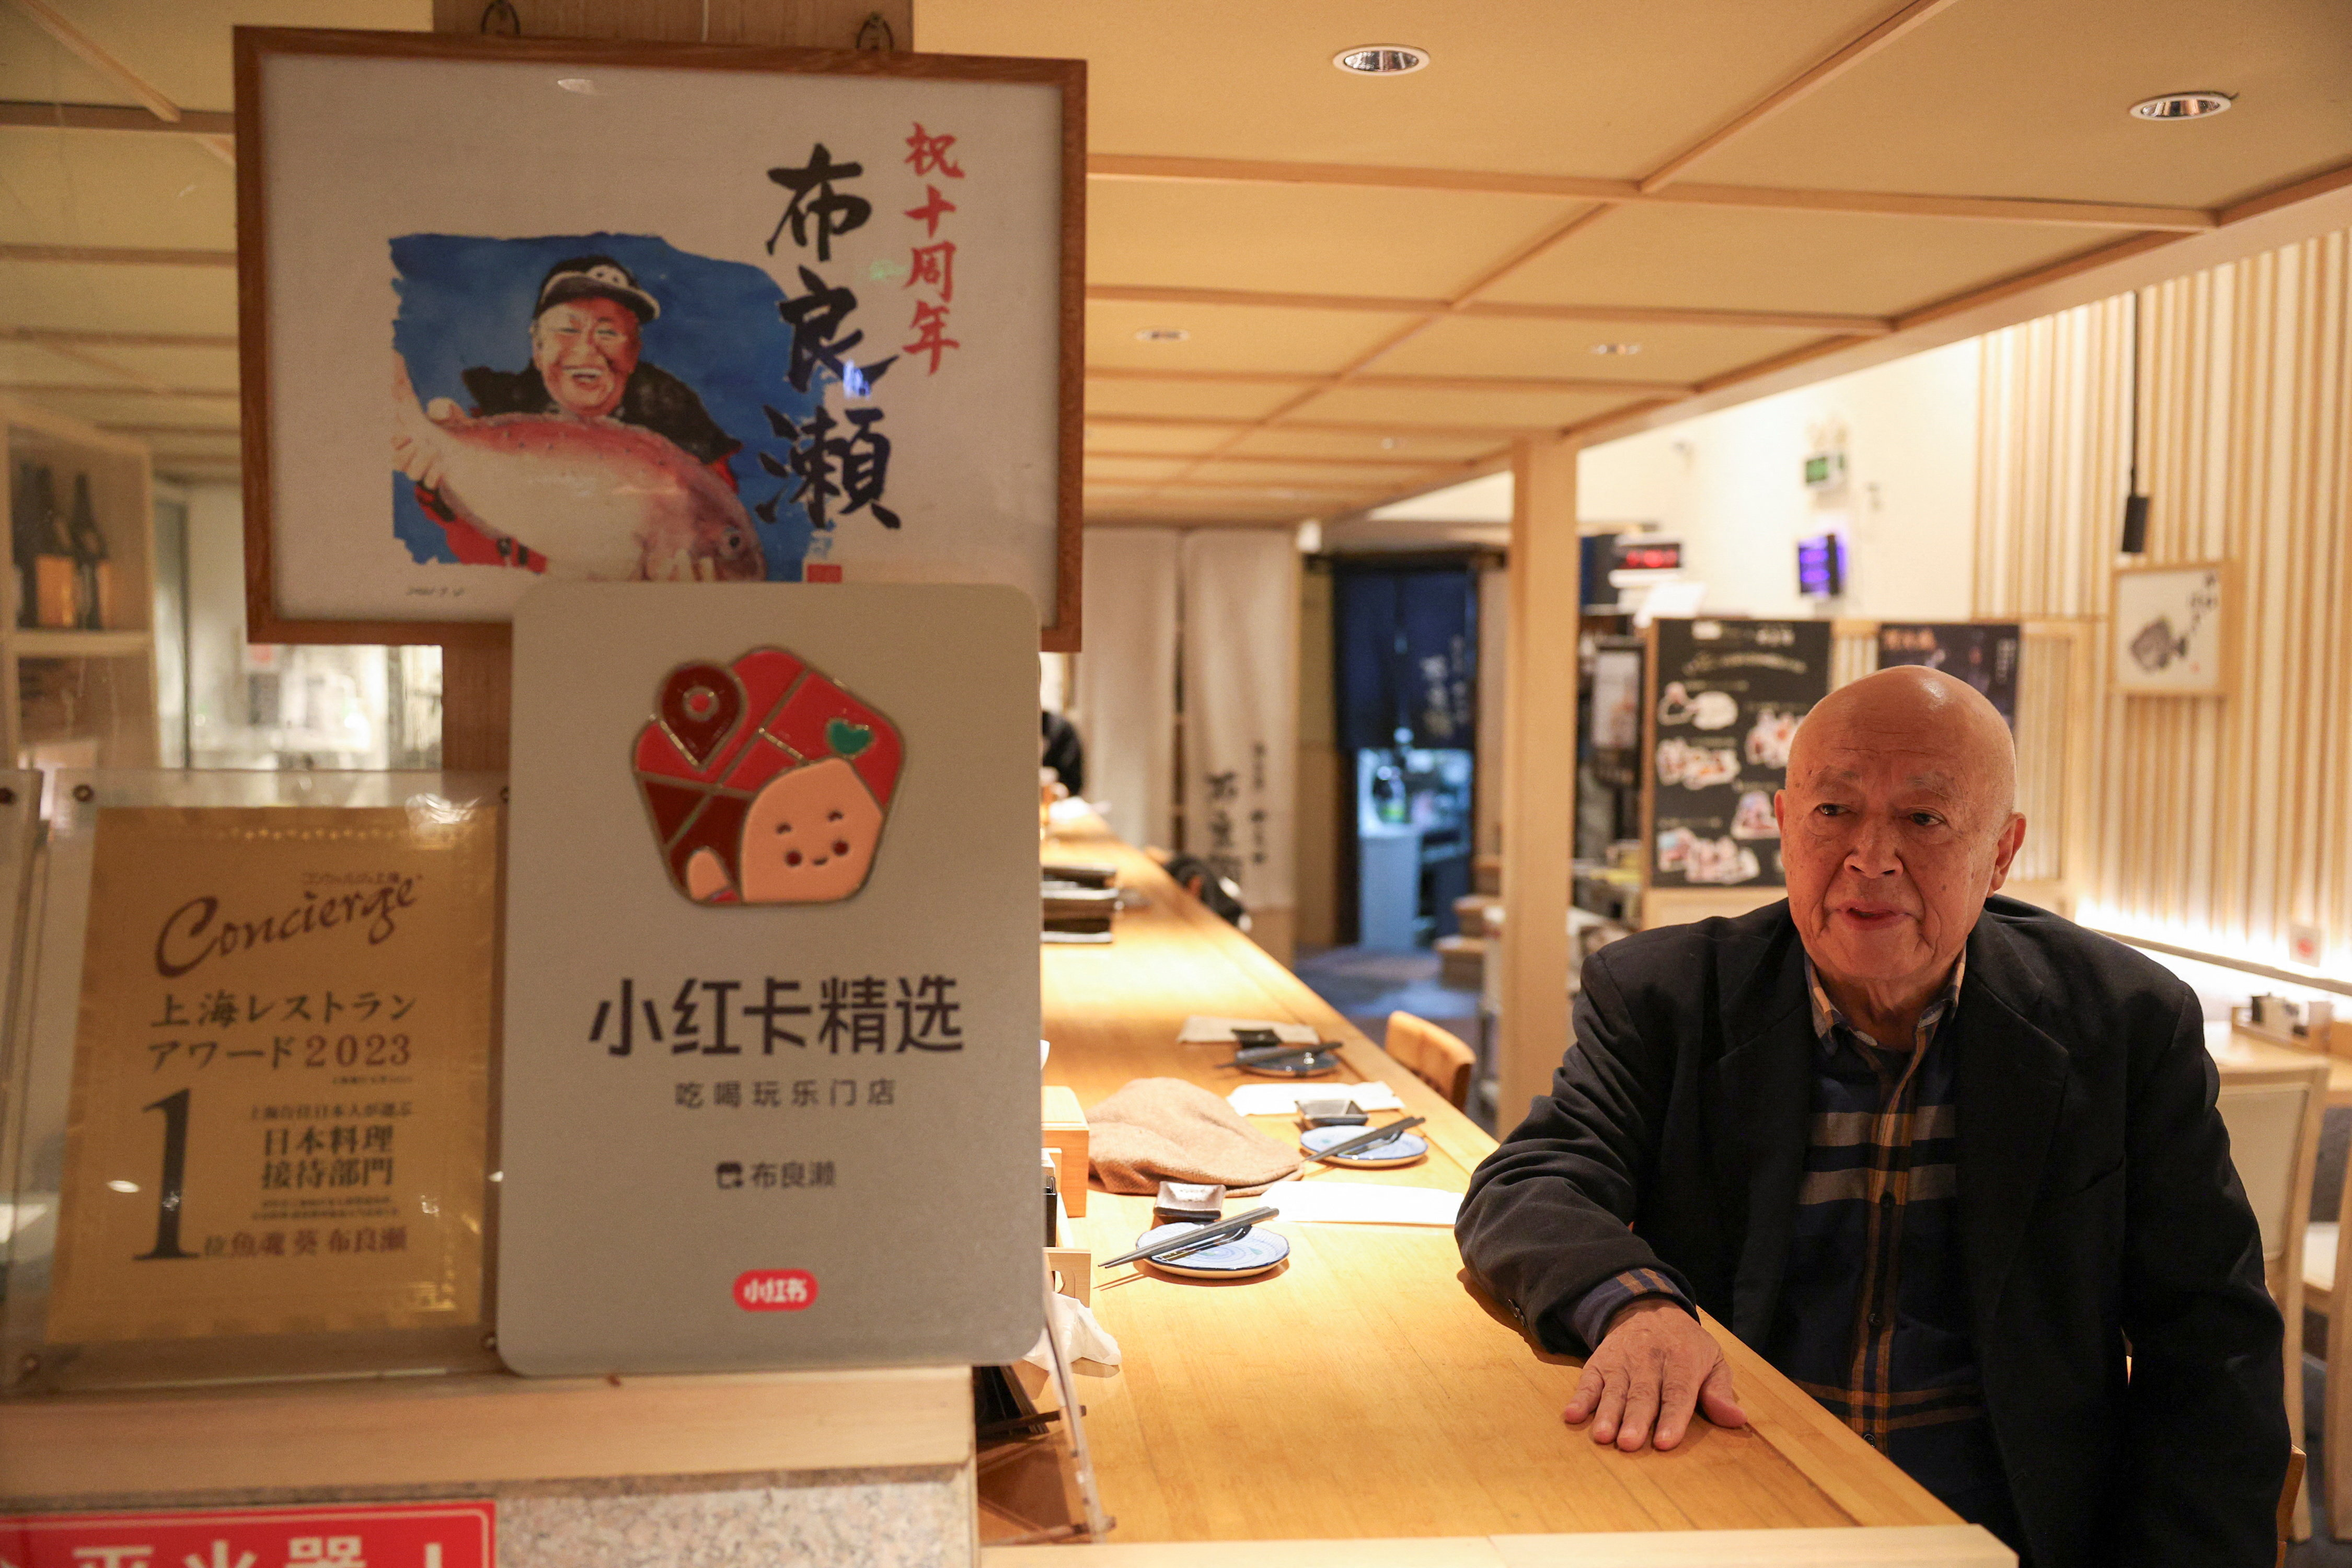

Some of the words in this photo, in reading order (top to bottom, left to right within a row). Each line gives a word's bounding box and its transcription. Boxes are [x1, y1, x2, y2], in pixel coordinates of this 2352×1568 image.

[903, 121, 965, 376] 祝十周年
[155, 877, 418, 978] Concierge
[151, 990, 417, 1029] 上海レストラン
[589, 974, 965, 1057] 小红卡精选
[674, 1077, 897, 1109] 吃喝玩乐门店
[263, 1124, 394, 1157] 日本料理
[132, 1086, 202, 1262] 1
[262, 1157, 394, 1190] 接待部門
